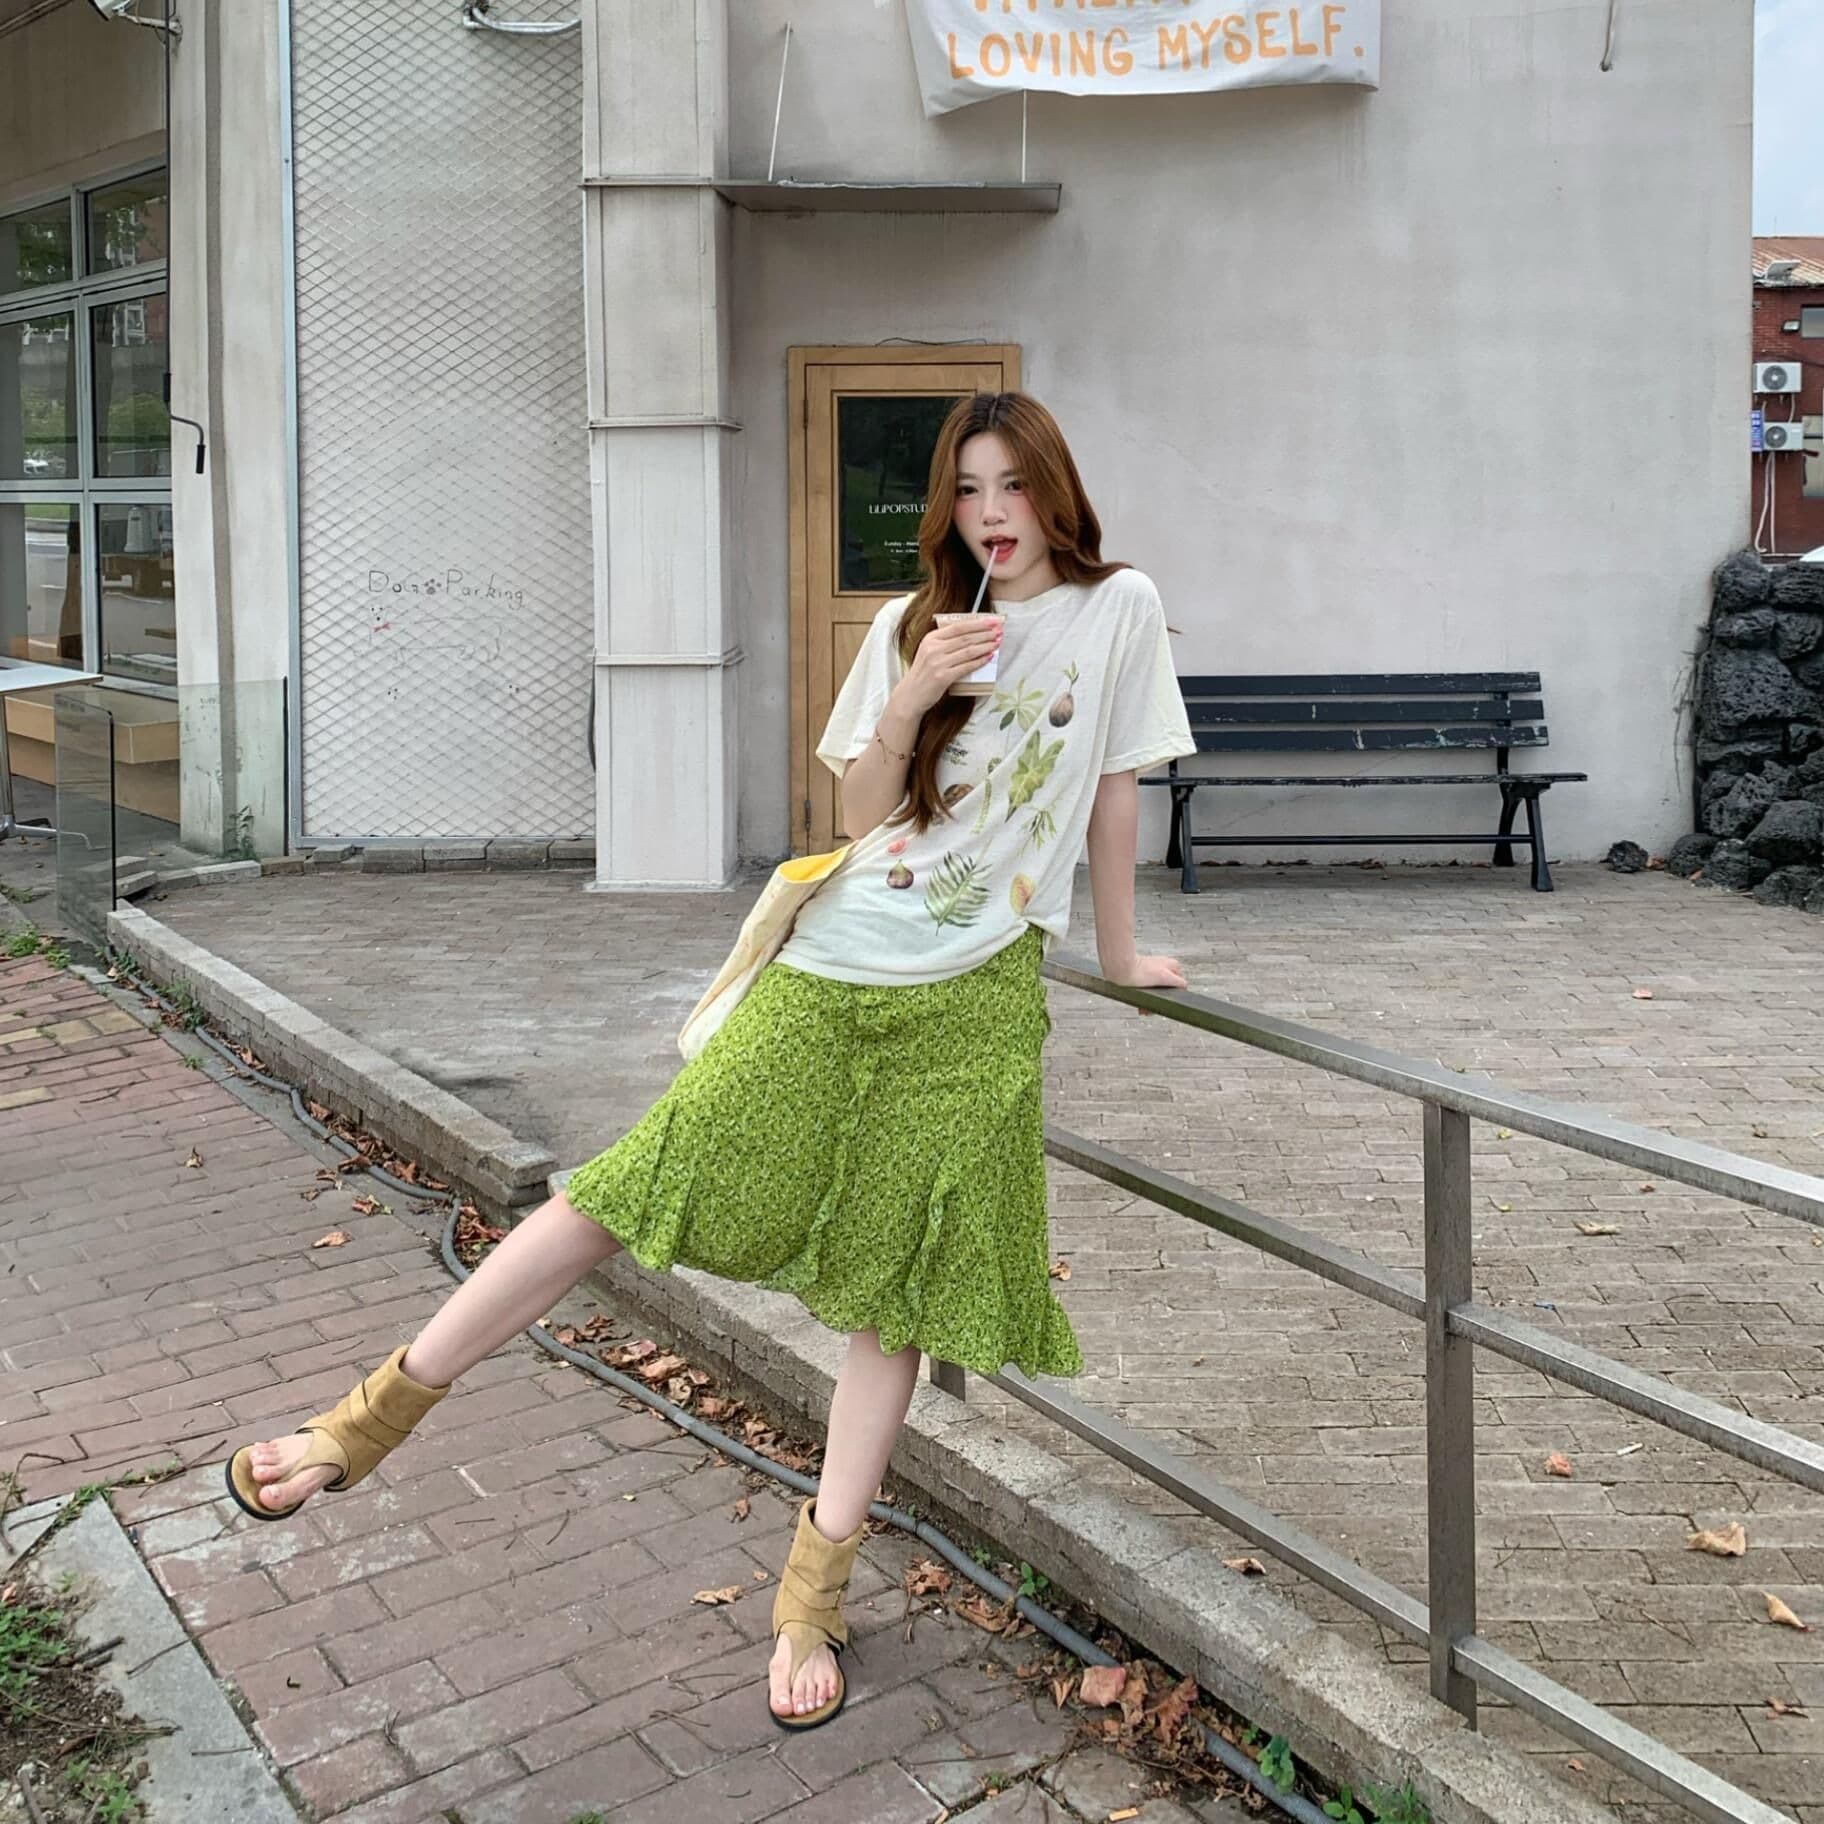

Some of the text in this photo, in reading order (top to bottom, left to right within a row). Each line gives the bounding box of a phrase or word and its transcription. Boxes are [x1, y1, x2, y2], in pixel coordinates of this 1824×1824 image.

[947, 4, 1364, 79] LOVING MYSELF.
[446, 568, 523, 610] Parking
